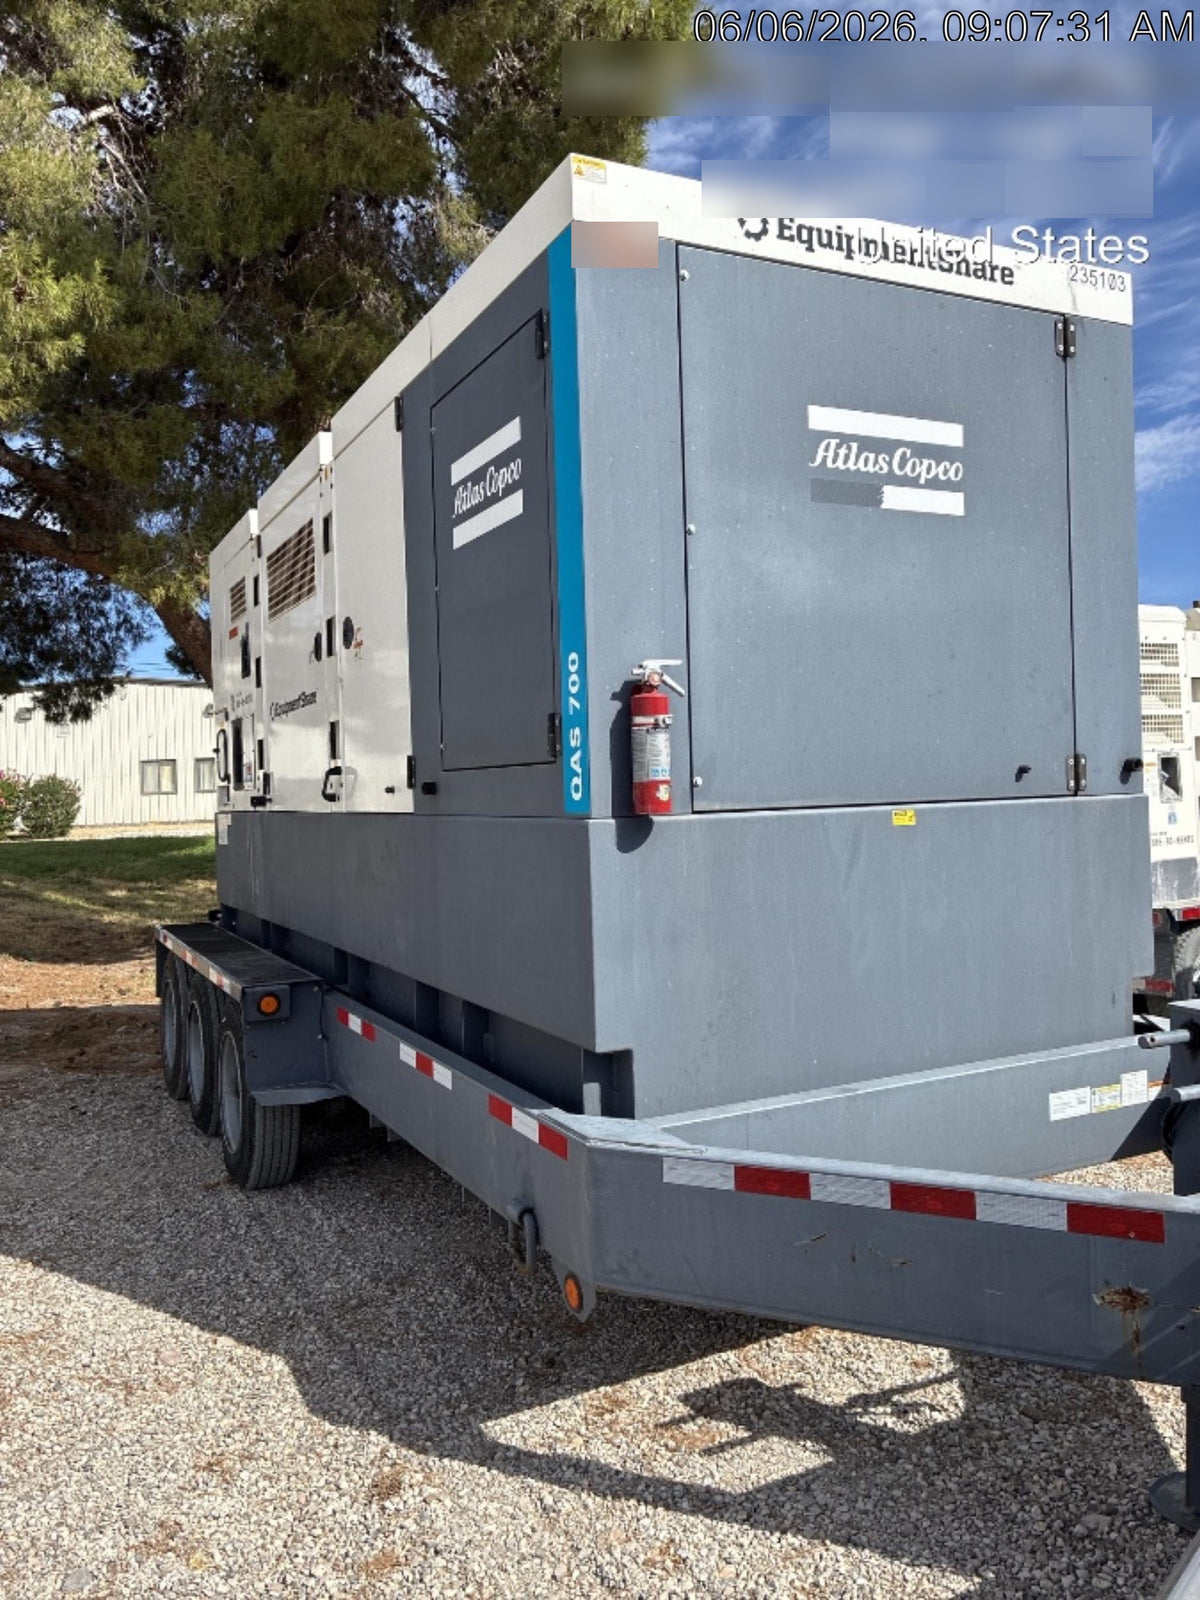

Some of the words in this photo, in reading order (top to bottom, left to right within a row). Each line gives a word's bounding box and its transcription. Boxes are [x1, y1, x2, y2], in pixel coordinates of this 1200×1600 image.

[1069, 264, 1127, 292] 235103
[452, 481, 485, 518] Atlas
[486, 458, 522, 497] Copco
[808, 438, 890, 474] Atlas
[892, 447, 964, 484] Copco
[568, 652, 581, 715] 700
[570, 726, 583, 801] QAS
